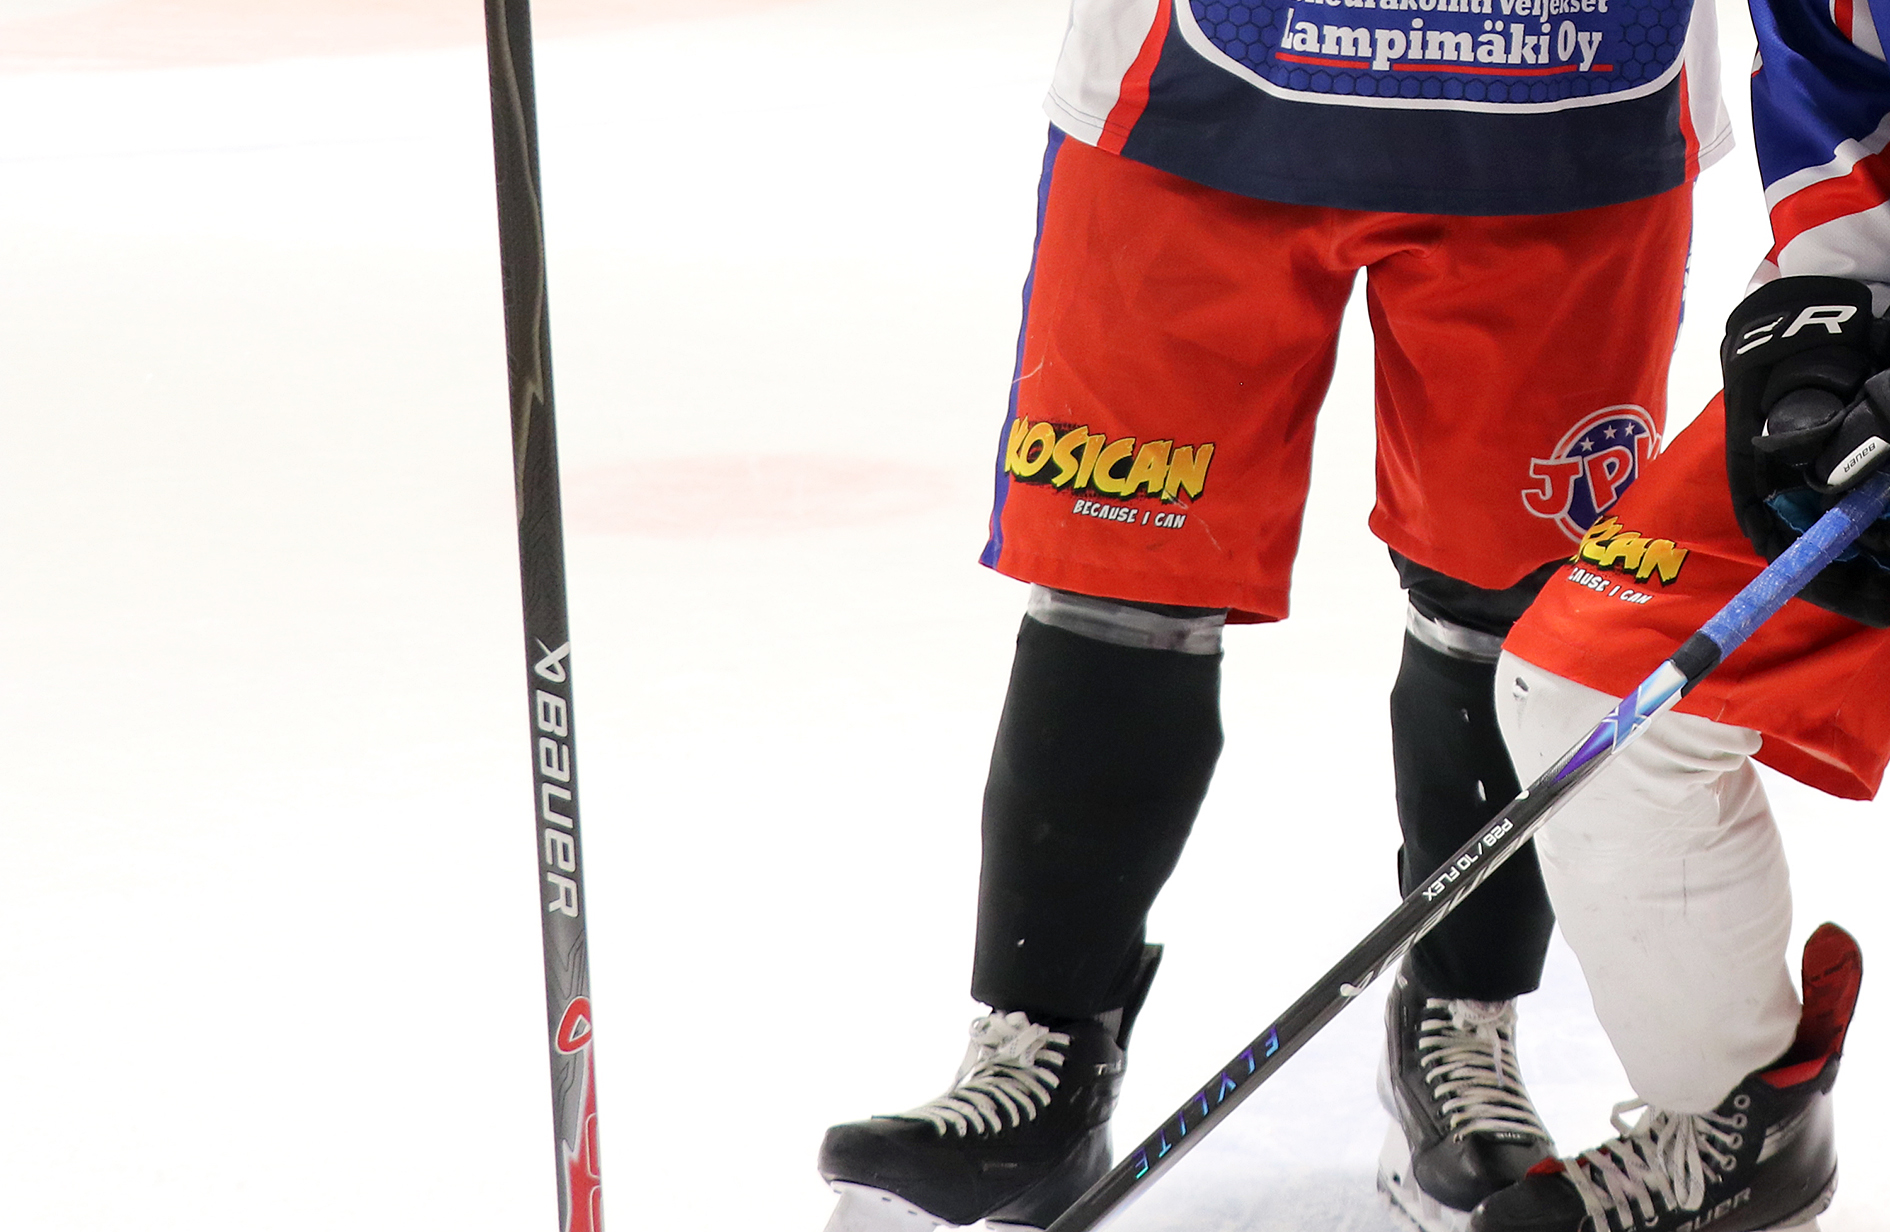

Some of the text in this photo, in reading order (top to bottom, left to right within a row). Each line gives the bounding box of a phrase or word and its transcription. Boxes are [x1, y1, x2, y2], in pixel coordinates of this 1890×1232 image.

[1280, 7, 1603, 72] Lampimäki Oy
[1072, 499, 1187, 529] BECAUSE I CAN
[1608, 585, 1621, 597] I
[1620, 589, 1654, 605] CAN
[535, 688, 580, 919] BAUER
[1482, 817, 1514, 847] P28
[1422, 868, 1461, 902] FLEX
[1131, 1023, 1281, 1180] FLYLITE
